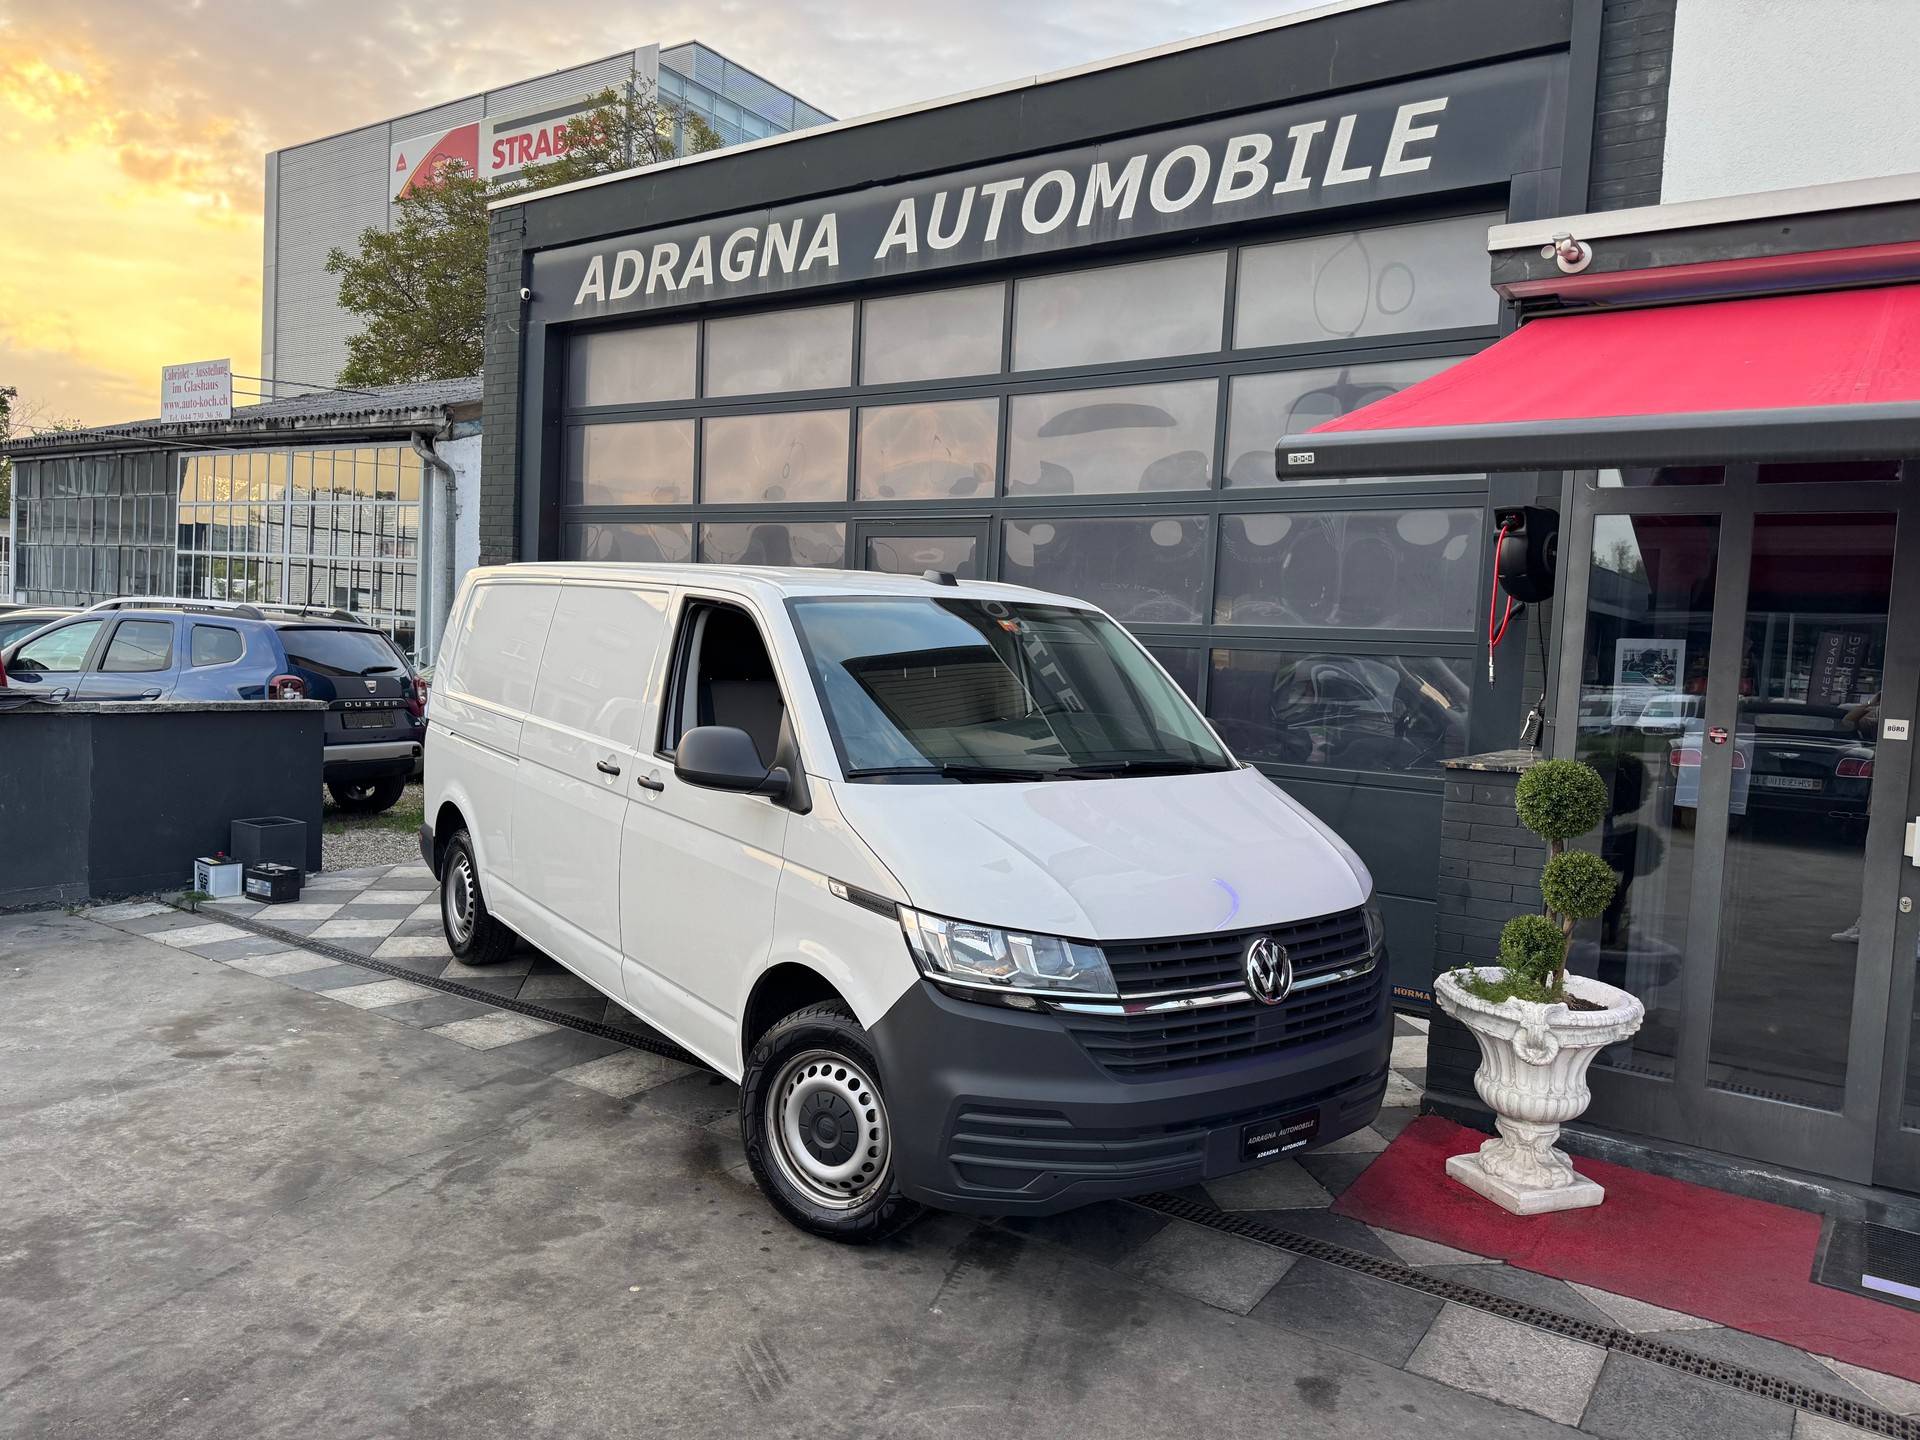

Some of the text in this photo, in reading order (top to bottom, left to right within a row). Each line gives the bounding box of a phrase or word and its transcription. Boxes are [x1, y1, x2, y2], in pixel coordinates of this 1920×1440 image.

[574, 97, 1449, 306] ADRAGNA AUTOMOBILE
[195, 363, 228, 379] Ausstellung
[172, 380, 219, 394] im Glashaus
[164, 394, 228, 411] www.auto-koch.ch
[180, 413, 192, 421] 044
[344, 700, 398, 708] DUSTER
[1247, 1120, 1315, 1145] ADRAGNA AUTOMOBILE
[1256, 1139, 1308, 1159] ADRAGNA AUTOMOBILE
